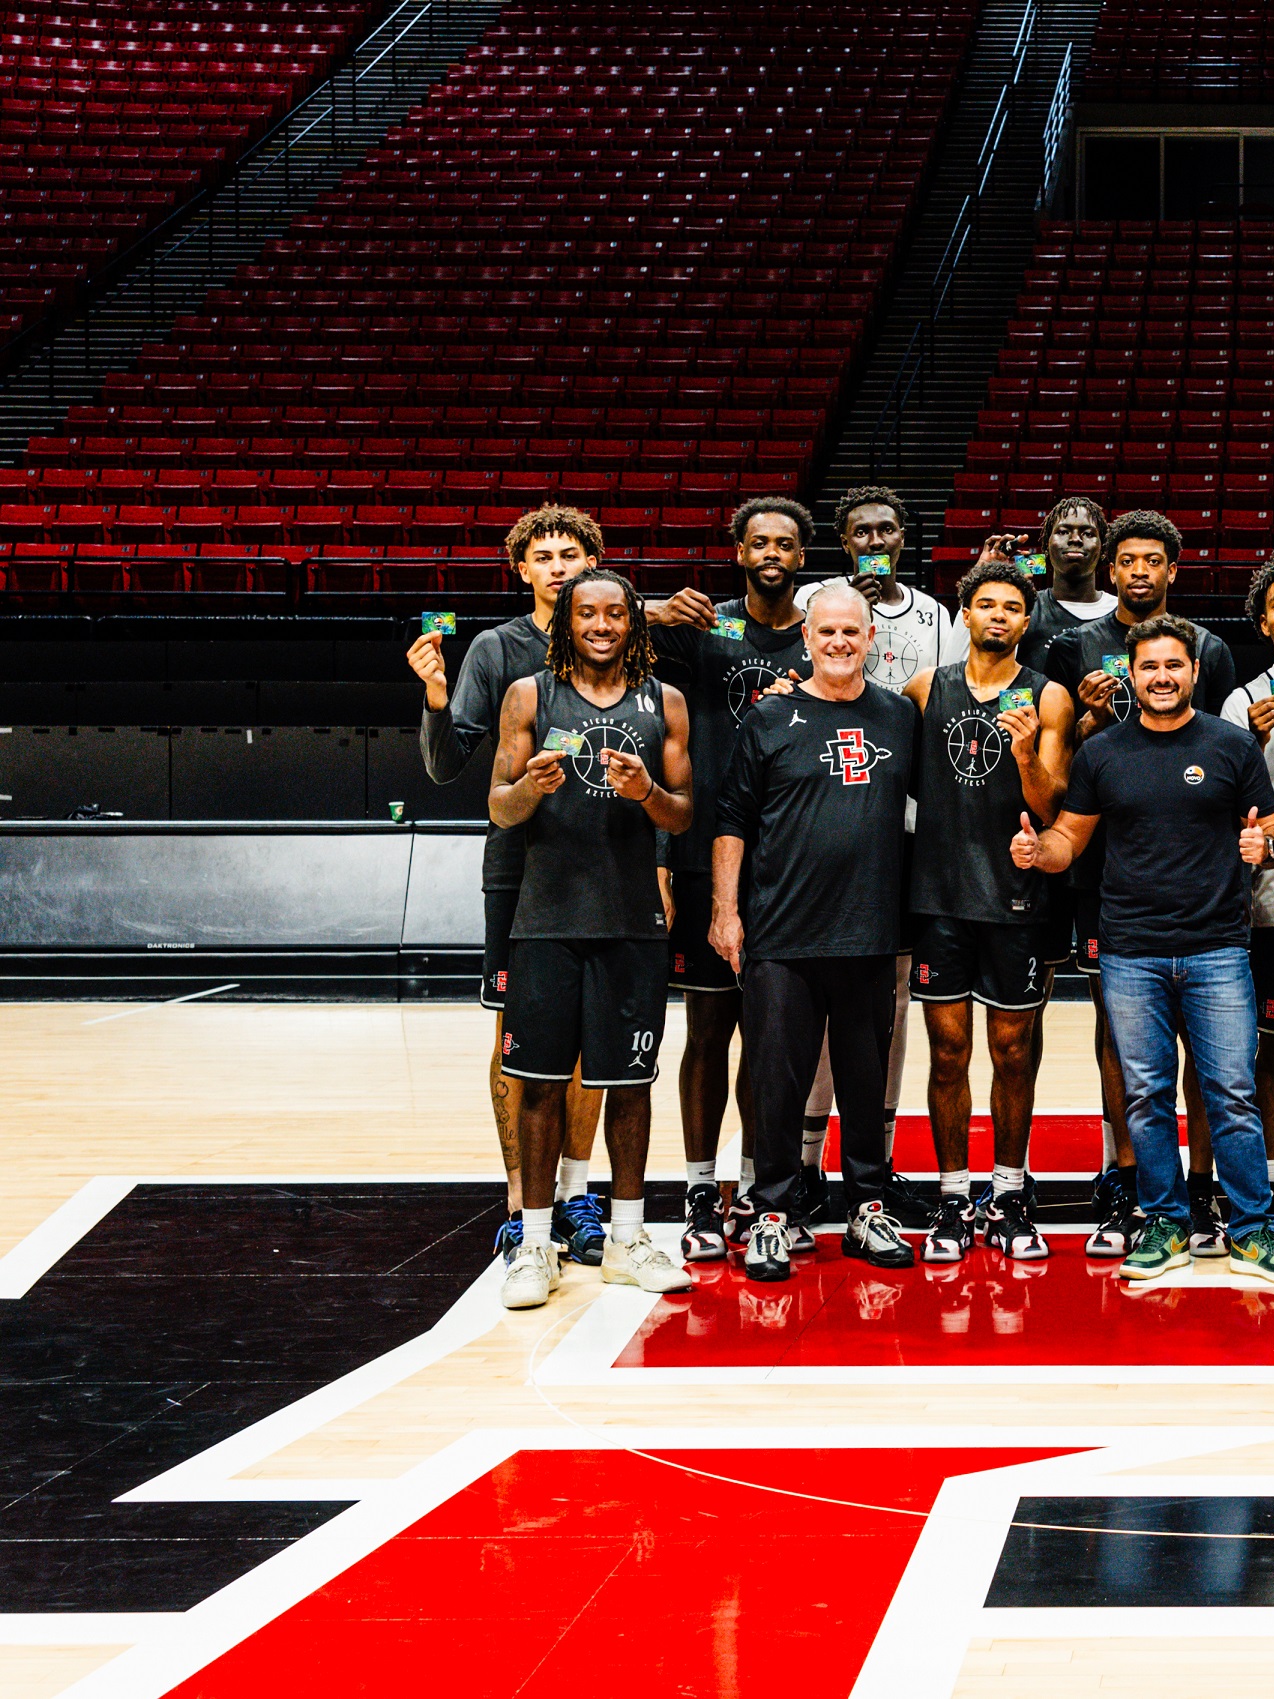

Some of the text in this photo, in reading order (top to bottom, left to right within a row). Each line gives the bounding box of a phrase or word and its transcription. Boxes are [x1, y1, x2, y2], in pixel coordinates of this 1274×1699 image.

[916, 609, 933, 627] 33
[741, 658, 772, 667] DIEGO
[634, 693, 656, 714] 10
[582, 717, 645, 749] DIEGO STATE
[943, 717, 956, 734] SAN
[954, 774, 985, 787] AZTECS
[585, 787, 618, 799] AZTEC
[1028, 956, 1037, 977] 2
[631, 1030, 654, 1052] 10
